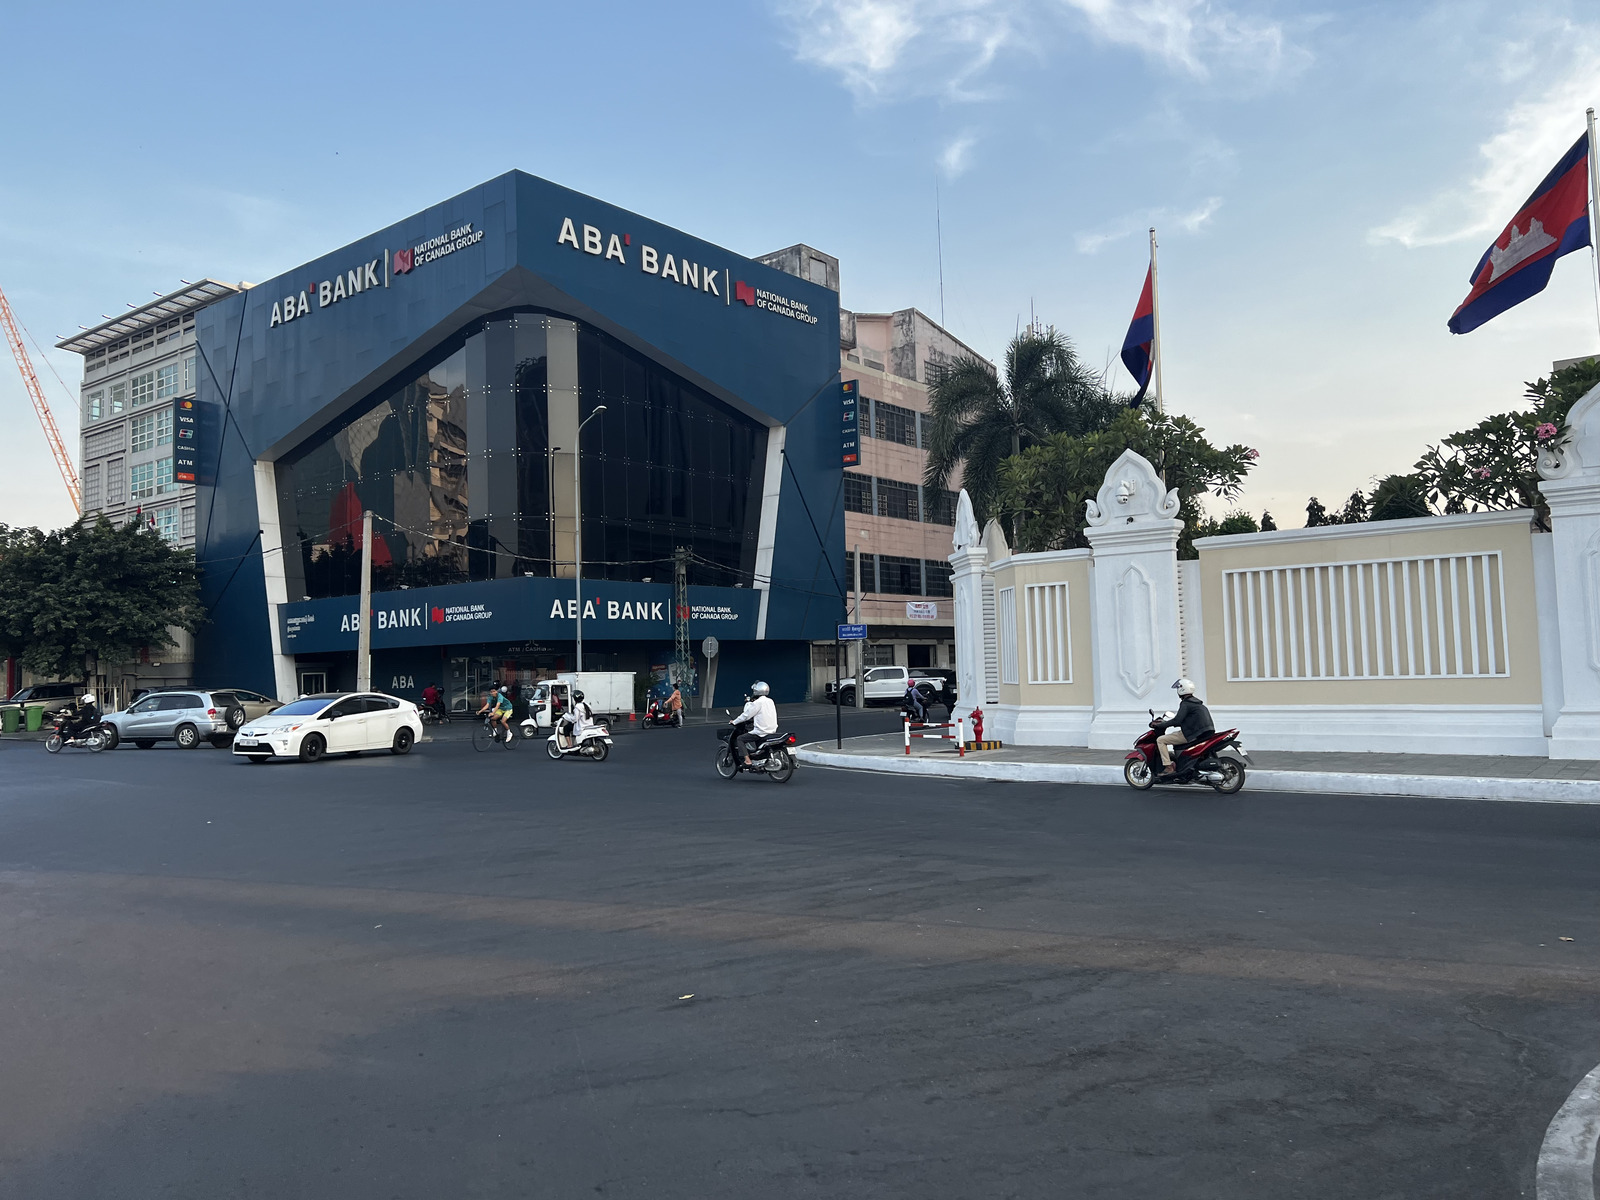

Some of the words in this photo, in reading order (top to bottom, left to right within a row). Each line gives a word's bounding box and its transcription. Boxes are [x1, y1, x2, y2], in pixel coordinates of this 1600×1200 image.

[414, 233, 450, 255] NATIONAL
[450, 223, 472, 241] BANK
[414, 254, 424, 267] OF
[425, 243, 455, 262] CANADA
[456, 230, 483, 249] GROUP
[642, 244, 720, 296] BANK
[319, 259, 379, 308] BANK
[756, 288, 789, 307] NATIONAL
[790, 299, 809, 313] BANK
[756, 298, 767, 308] OF
[767, 302, 795, 318] CANADA
[795, 311, 818, 325] GROUP
[341, 612, 360, 632] AB
[378, 607, 422, 630] BANK
[445, 605, 470, 614] NATIONAL
[470, 604, 485, 612] BANK
[445, 614, 453, 622] OF
[452, 613, 474, 621] CANADA
[473, 611, 493, 620] GROUP
[607, 600, 664, 621] BANK
[691, 605, 717, 613] NATIONAL
[691, 612, 700, 620] OF
[720, 613, 739, 621] GROUP
[391, 675, 415, 689] ABA
